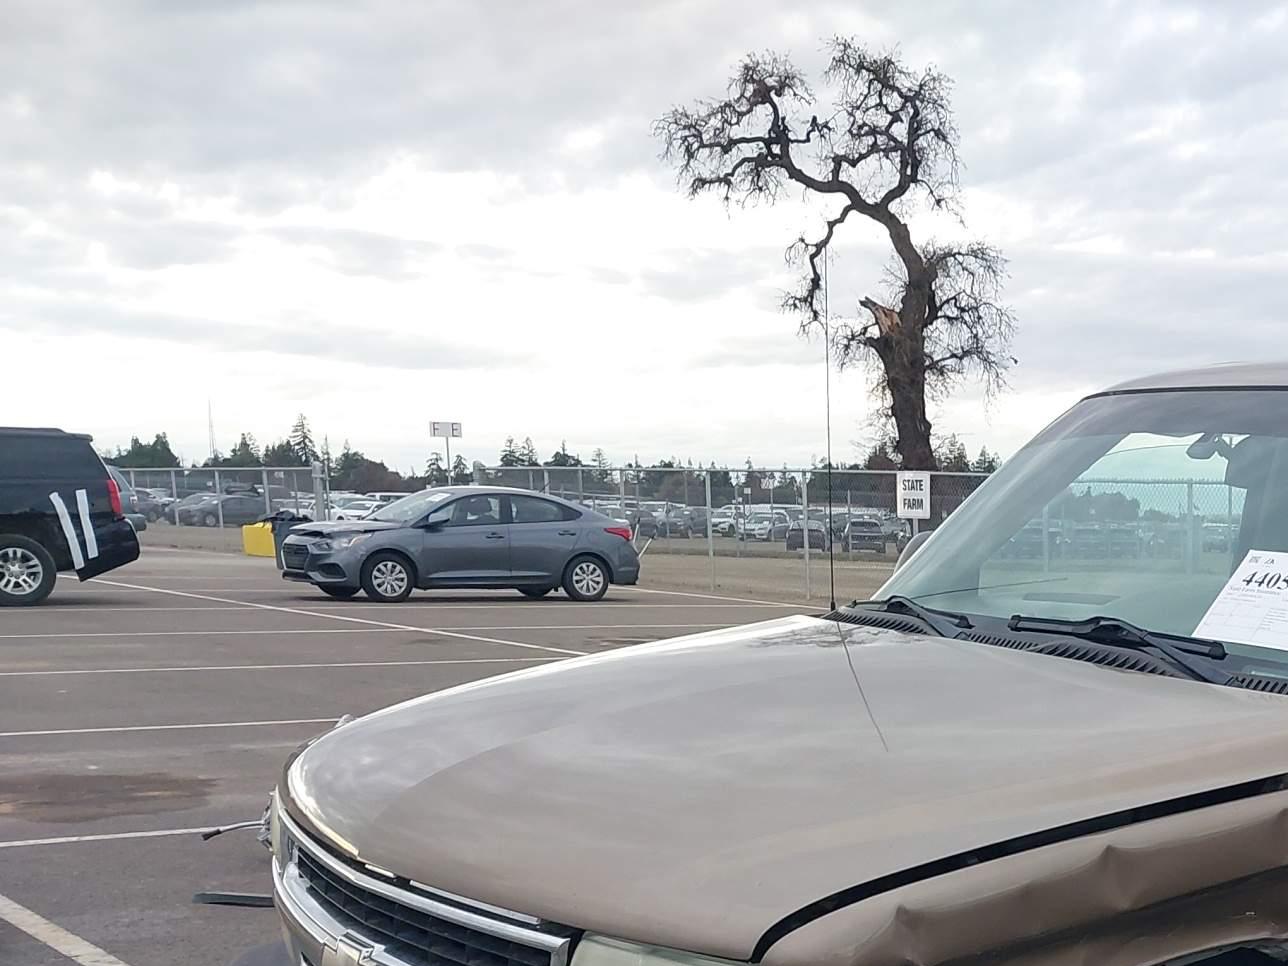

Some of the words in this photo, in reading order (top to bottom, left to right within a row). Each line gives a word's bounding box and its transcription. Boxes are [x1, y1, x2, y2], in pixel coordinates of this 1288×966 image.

[432, 421, 440, 437] F
[451, 422, 460, 438] E
[902, 478, 924, 491] STATE
[903, 498, 924, 511] FARM
